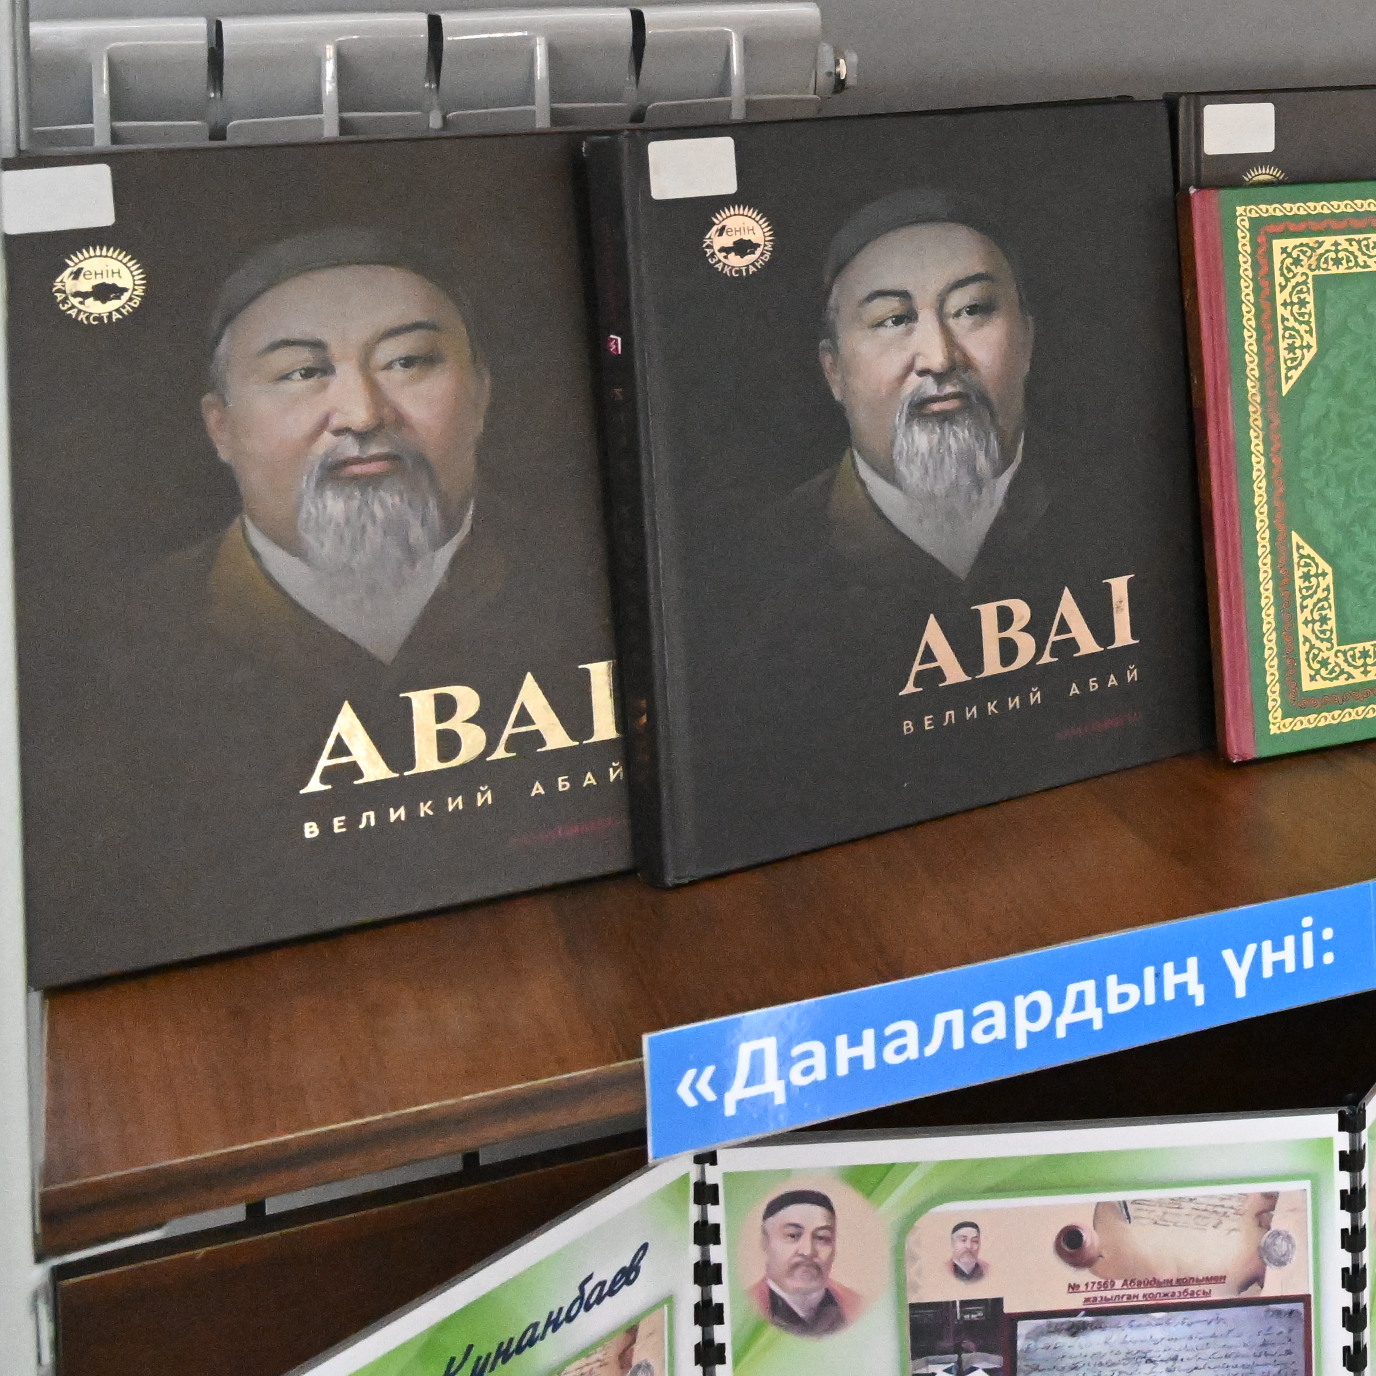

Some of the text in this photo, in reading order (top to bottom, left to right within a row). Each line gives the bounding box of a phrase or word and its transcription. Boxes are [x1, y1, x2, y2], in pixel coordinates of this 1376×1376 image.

[901, 686, 1044, 736] ВЕЛИКИЙ
[1068, 664, 1139, 698] АБАЙ
[302, 784, 495, 839] ВЕЛИКИЙ
[529, 762, 625, 798] АБАЙ
[674, 953, 1205, 1119] «Даналардың
[1220, 917, 1335, 1000] үні:
